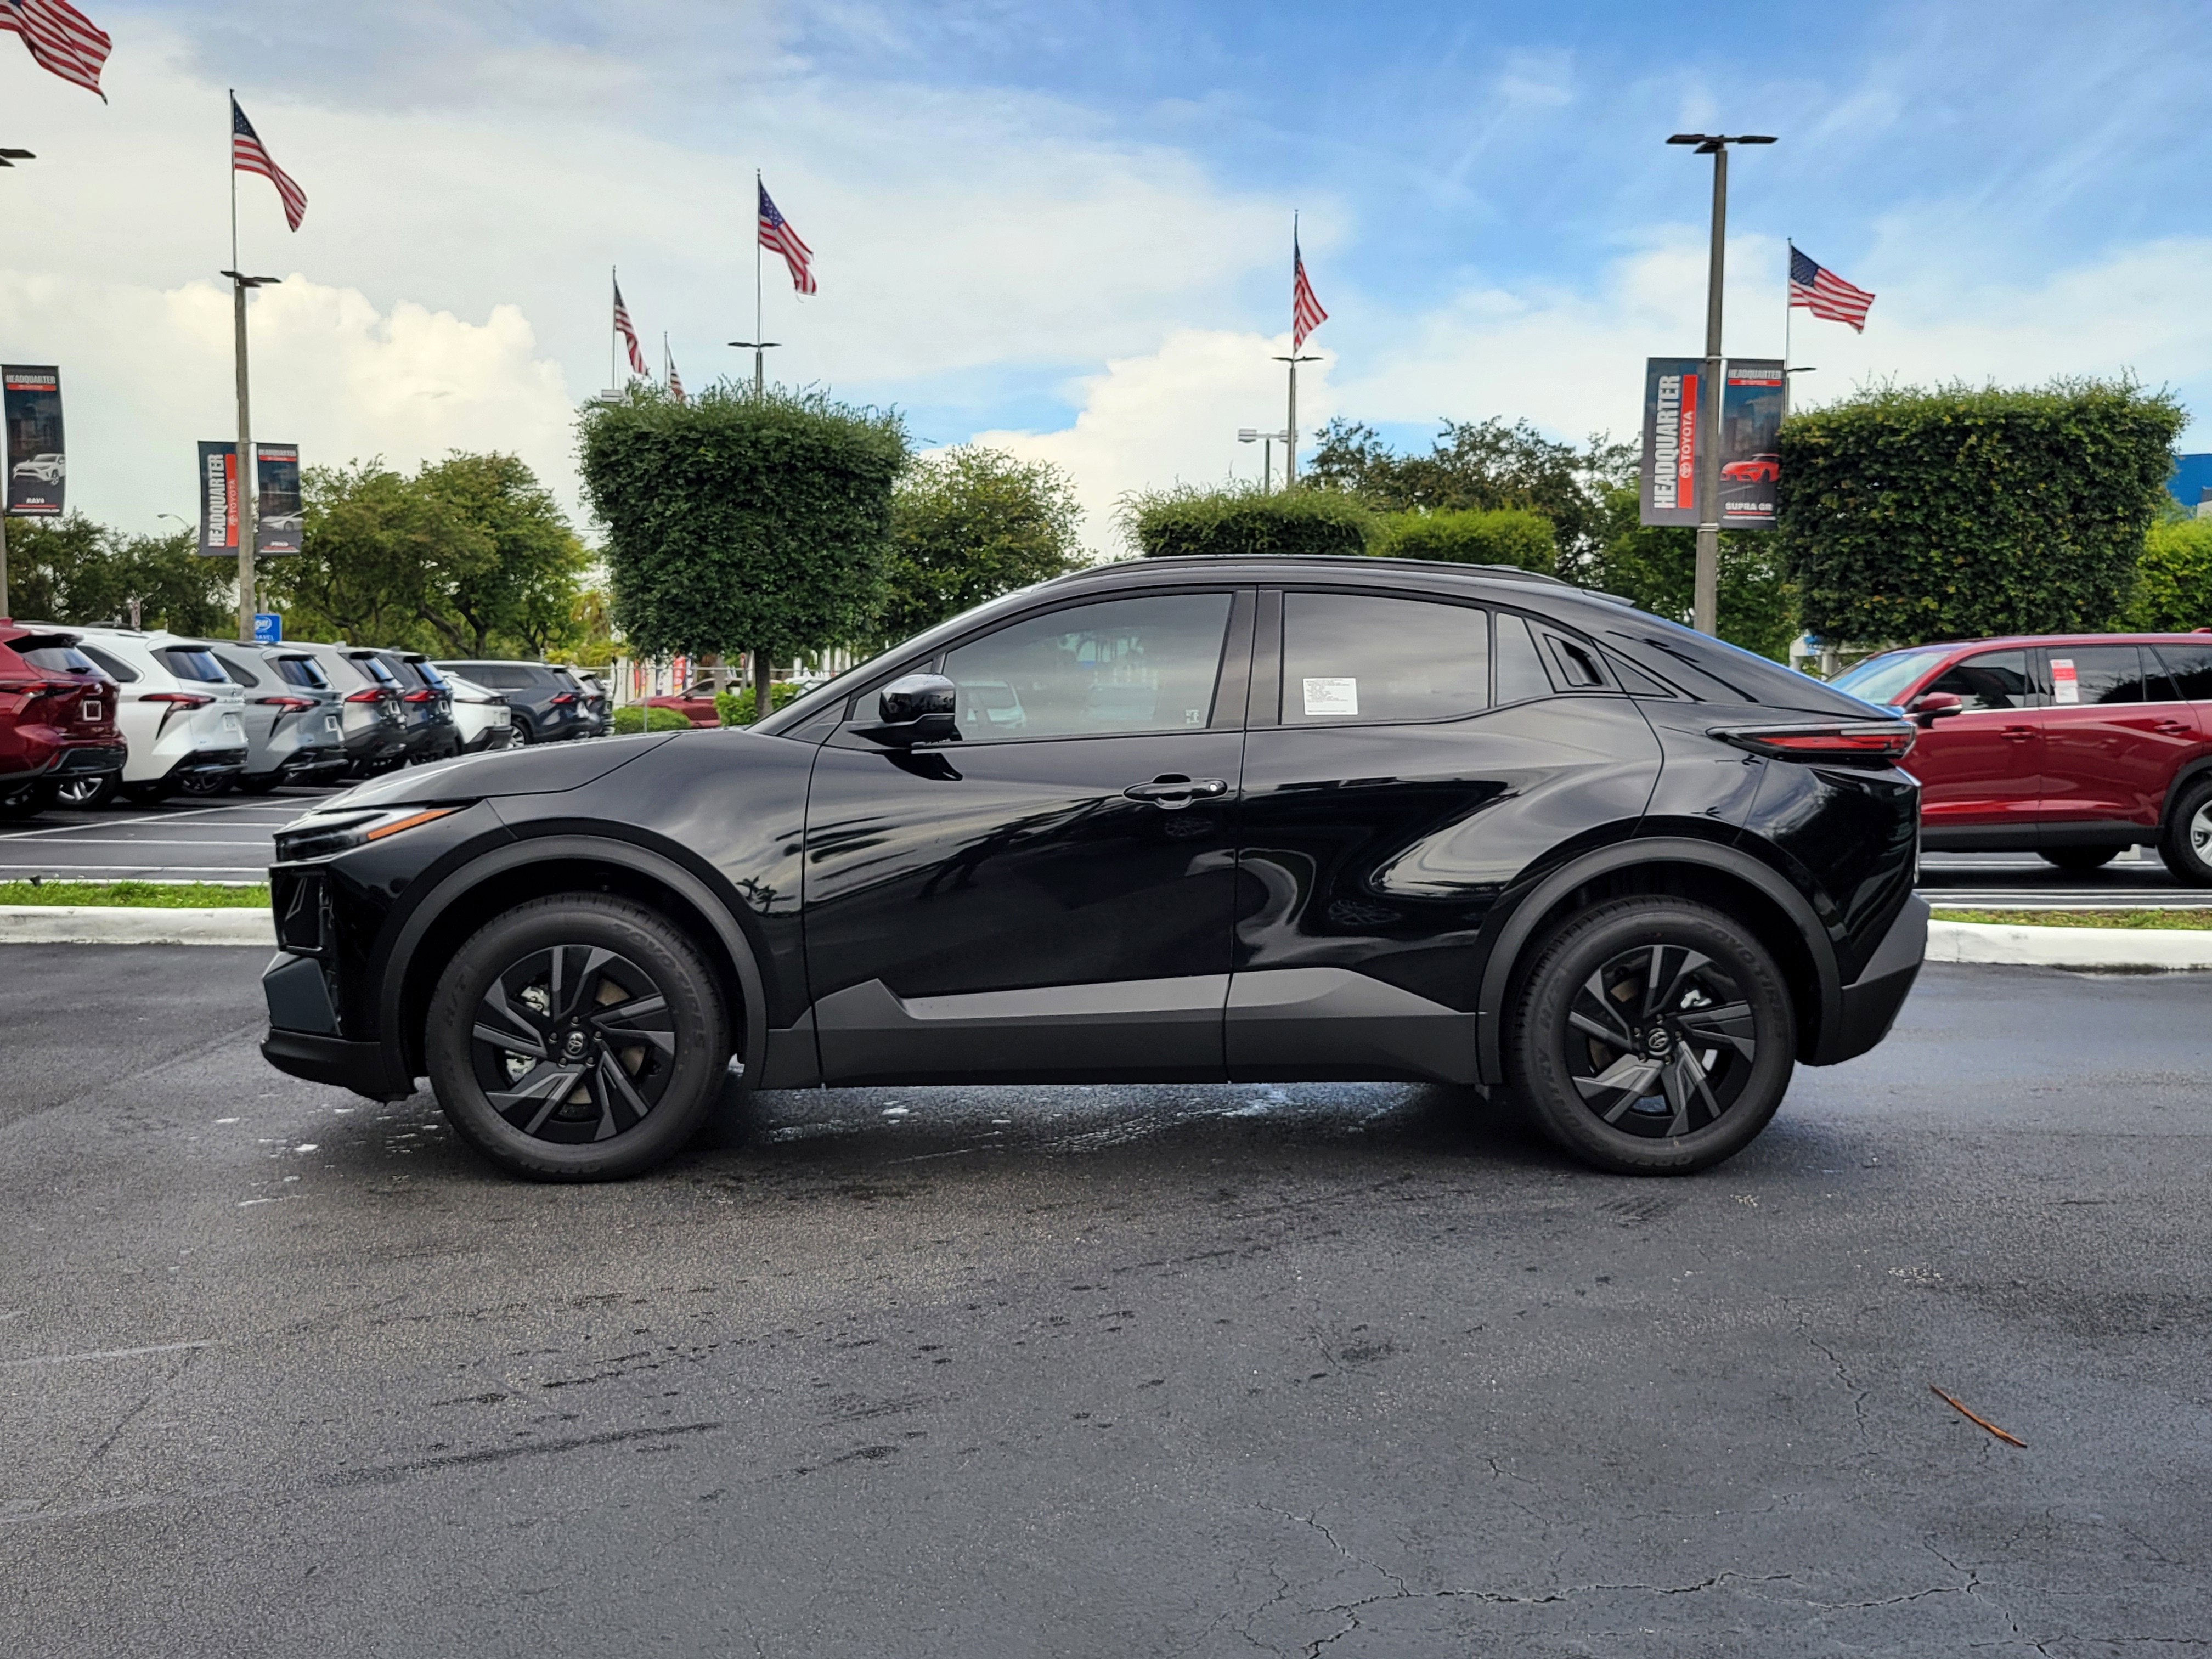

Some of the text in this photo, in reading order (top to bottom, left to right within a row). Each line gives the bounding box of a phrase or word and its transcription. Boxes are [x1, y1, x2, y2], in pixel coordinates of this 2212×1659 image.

[6, 374, 55, 384] HEADQUARTER
[1728, 369, 1781, 379] HEADQUARTER
[1654, 375, 1680, 508] HEADQUARTER
[1681, 411, 1694, 461] TOYOTA
[208, 454, 227, 546] HEADQUARTER
[228, 480, 237, 516] TOYOTA
[1725, 501, 1758, 510] SUPRA
